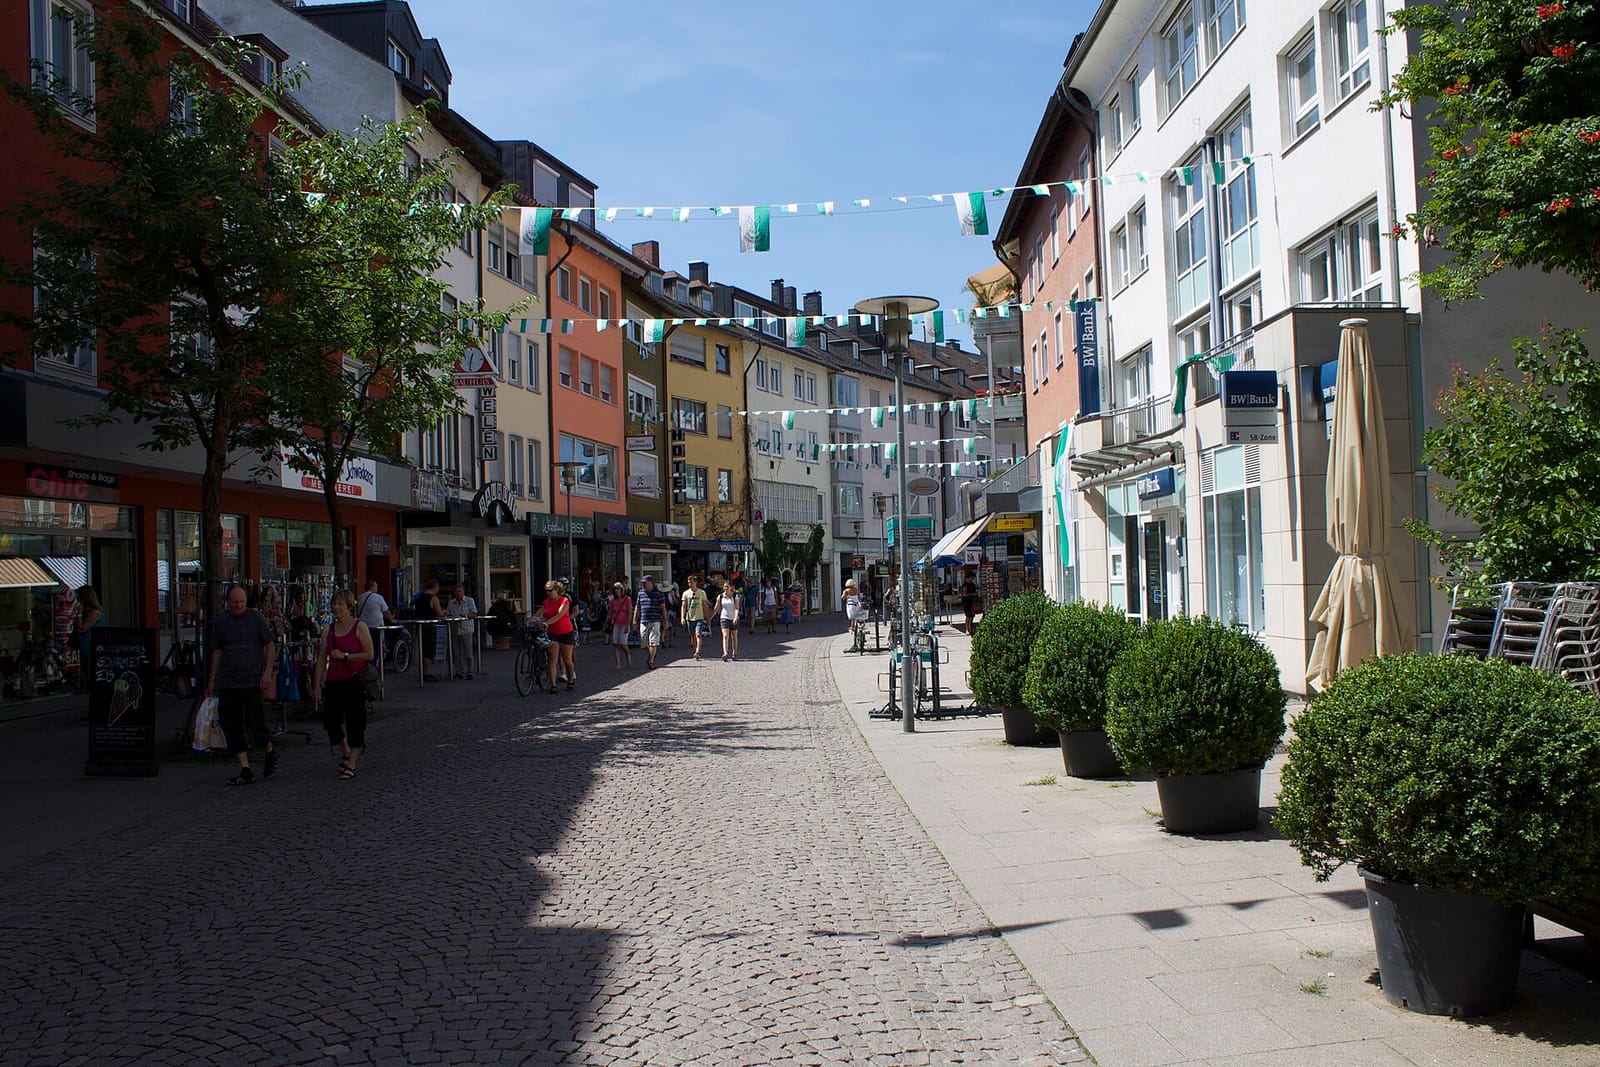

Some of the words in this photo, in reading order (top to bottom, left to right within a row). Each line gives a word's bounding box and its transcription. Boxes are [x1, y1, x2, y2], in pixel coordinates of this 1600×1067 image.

[1249, 433, 1276, 441] SB-Zone
[67, 469, 90, 480] Shoes
[90, 472, 97, 480] &
[98, 473, 116, 484] Bags
[672, 429, 683, 505] HOTEL
[29, 467, 89, 499] Chic
